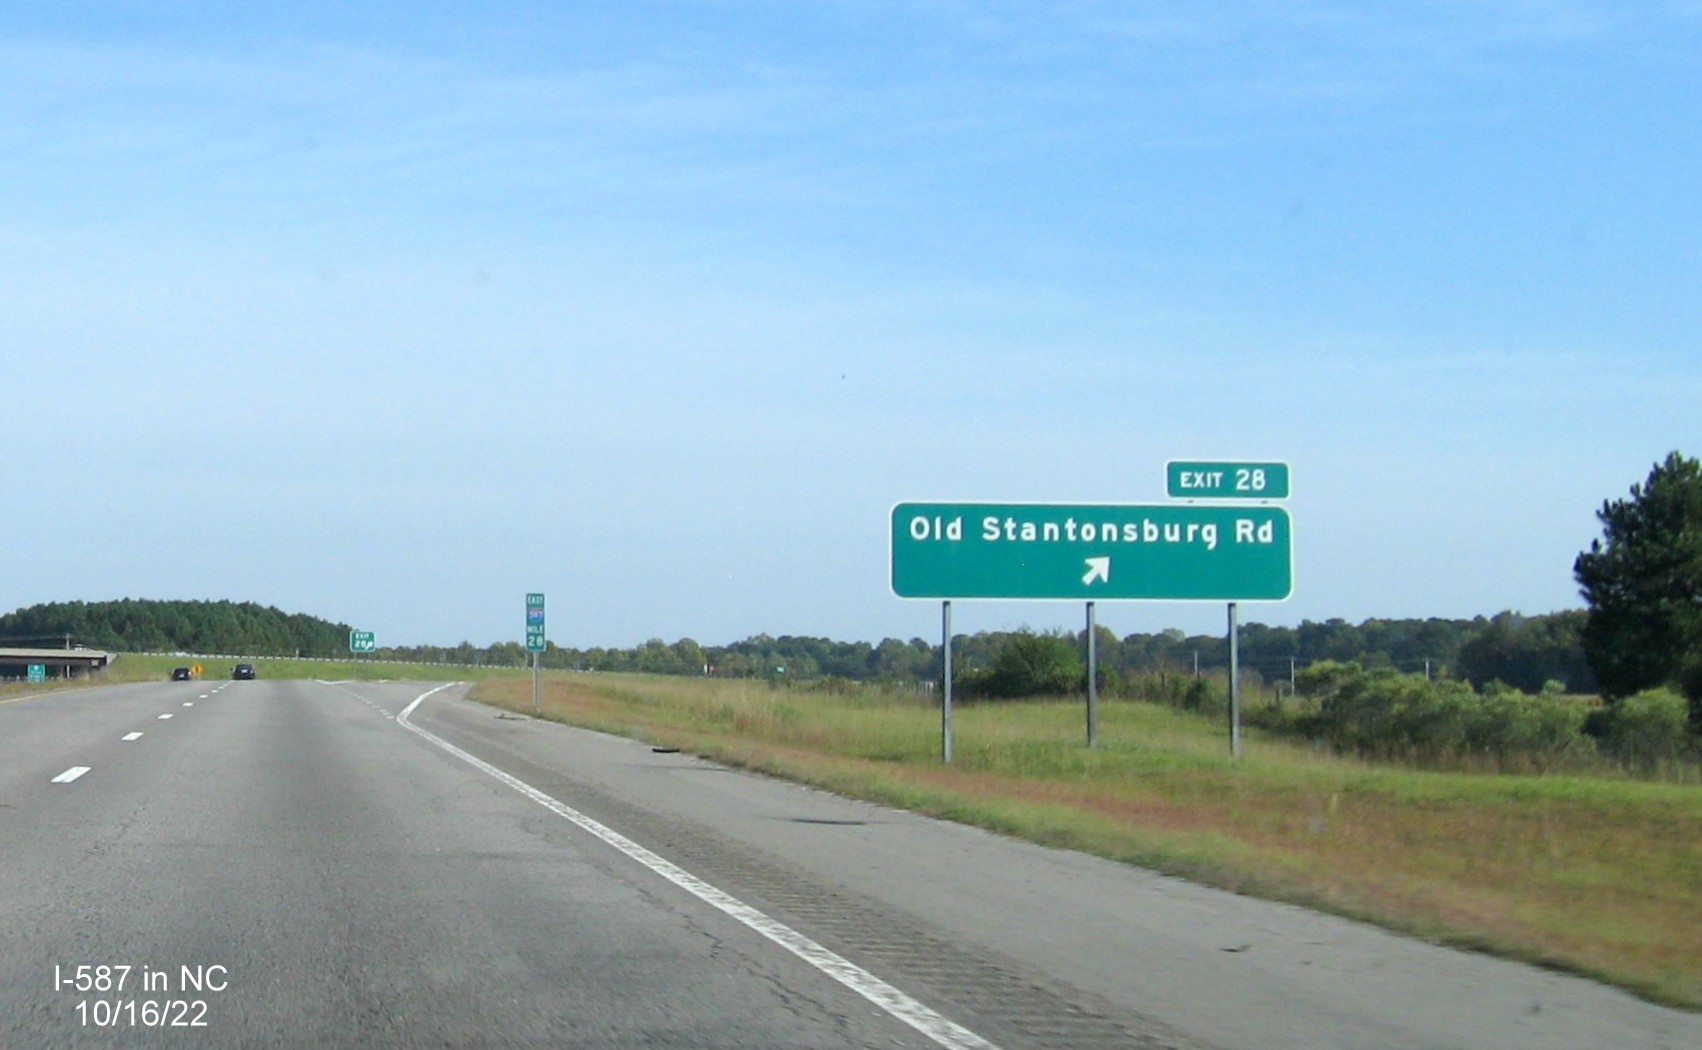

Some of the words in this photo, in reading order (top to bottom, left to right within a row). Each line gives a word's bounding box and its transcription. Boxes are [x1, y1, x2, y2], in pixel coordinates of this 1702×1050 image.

[1180, 471, 1223, 489] EXIT
[1236, 469, 1266, 491] 28
[909, 516, 962, 541] Old
[982, 516, 1218, 550] Stantonsburg
[1236, 519, 1273, 543] Rd
[527, 625, 544, 633] MILE
[354, 639, 367, 648] 28
[528, 635, 544, 647] 28
